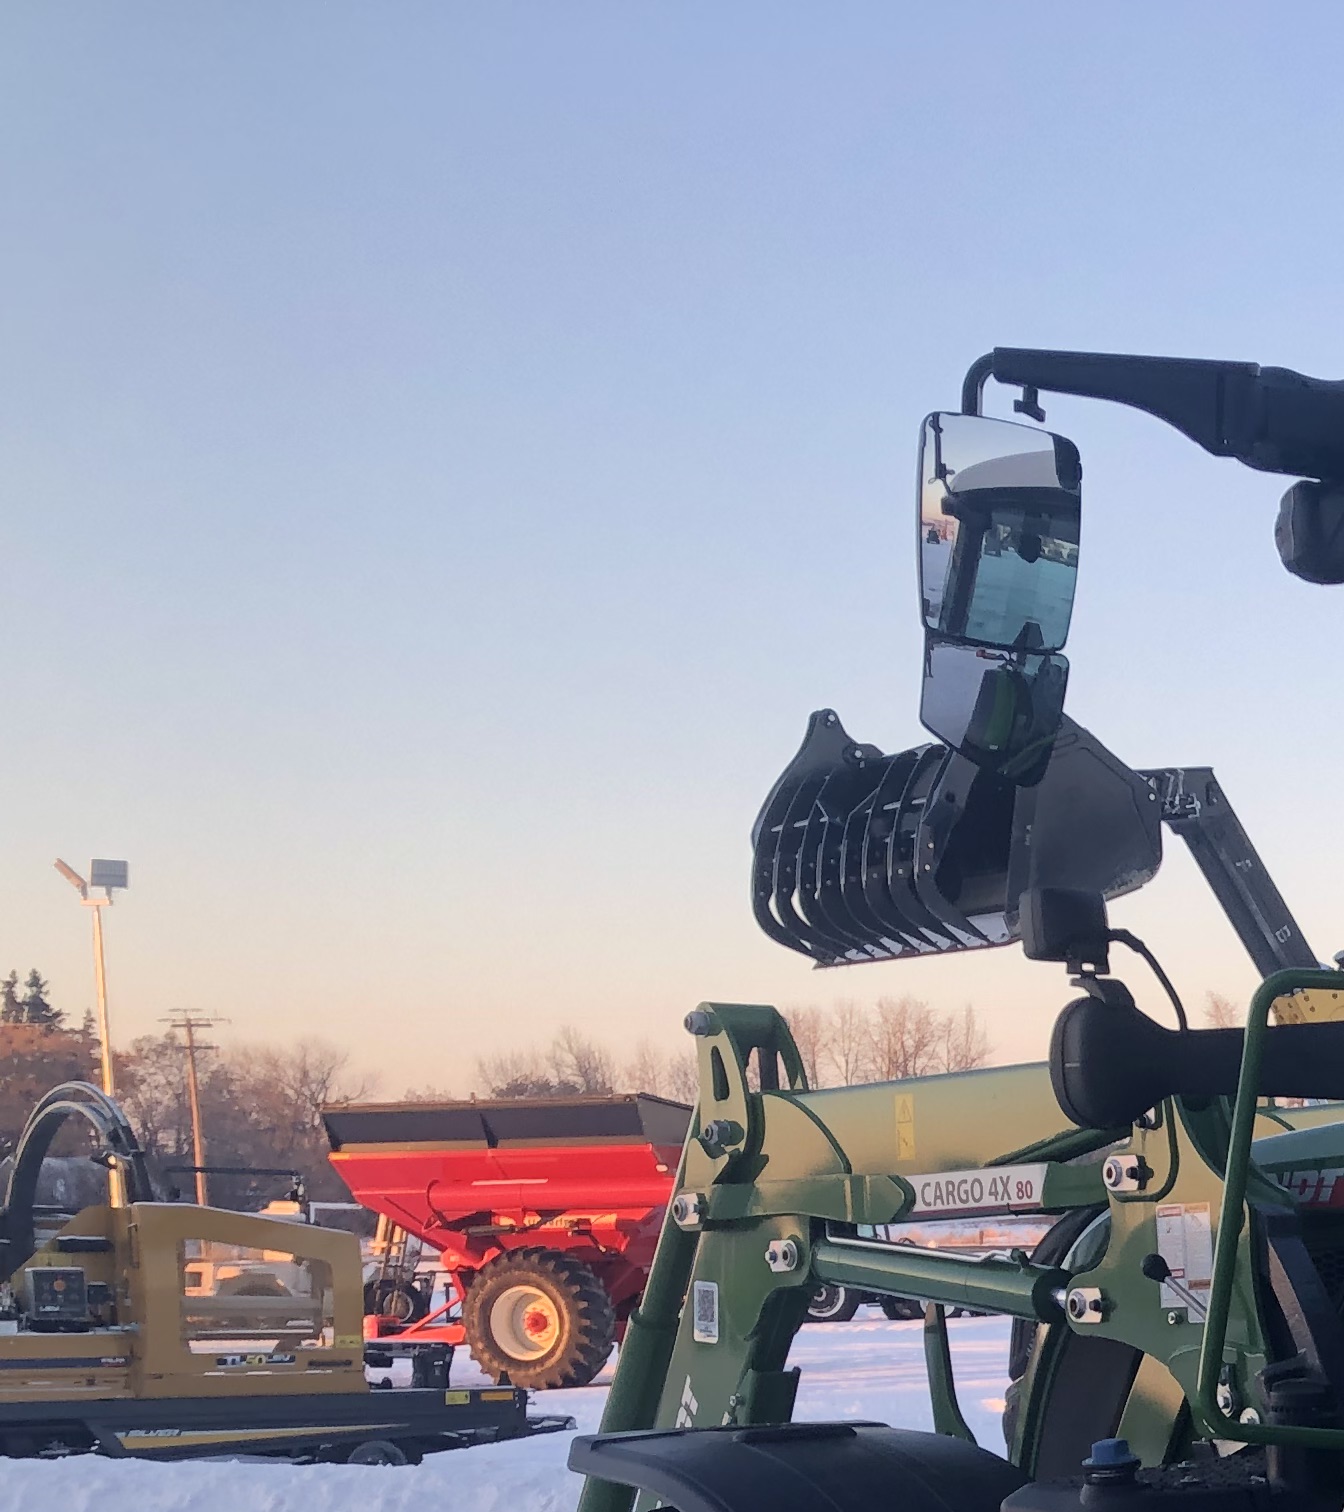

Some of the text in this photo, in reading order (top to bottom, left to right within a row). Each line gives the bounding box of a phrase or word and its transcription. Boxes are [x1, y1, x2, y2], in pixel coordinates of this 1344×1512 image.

[921, 1175, 1033, 1207] CARGO 4X 80
